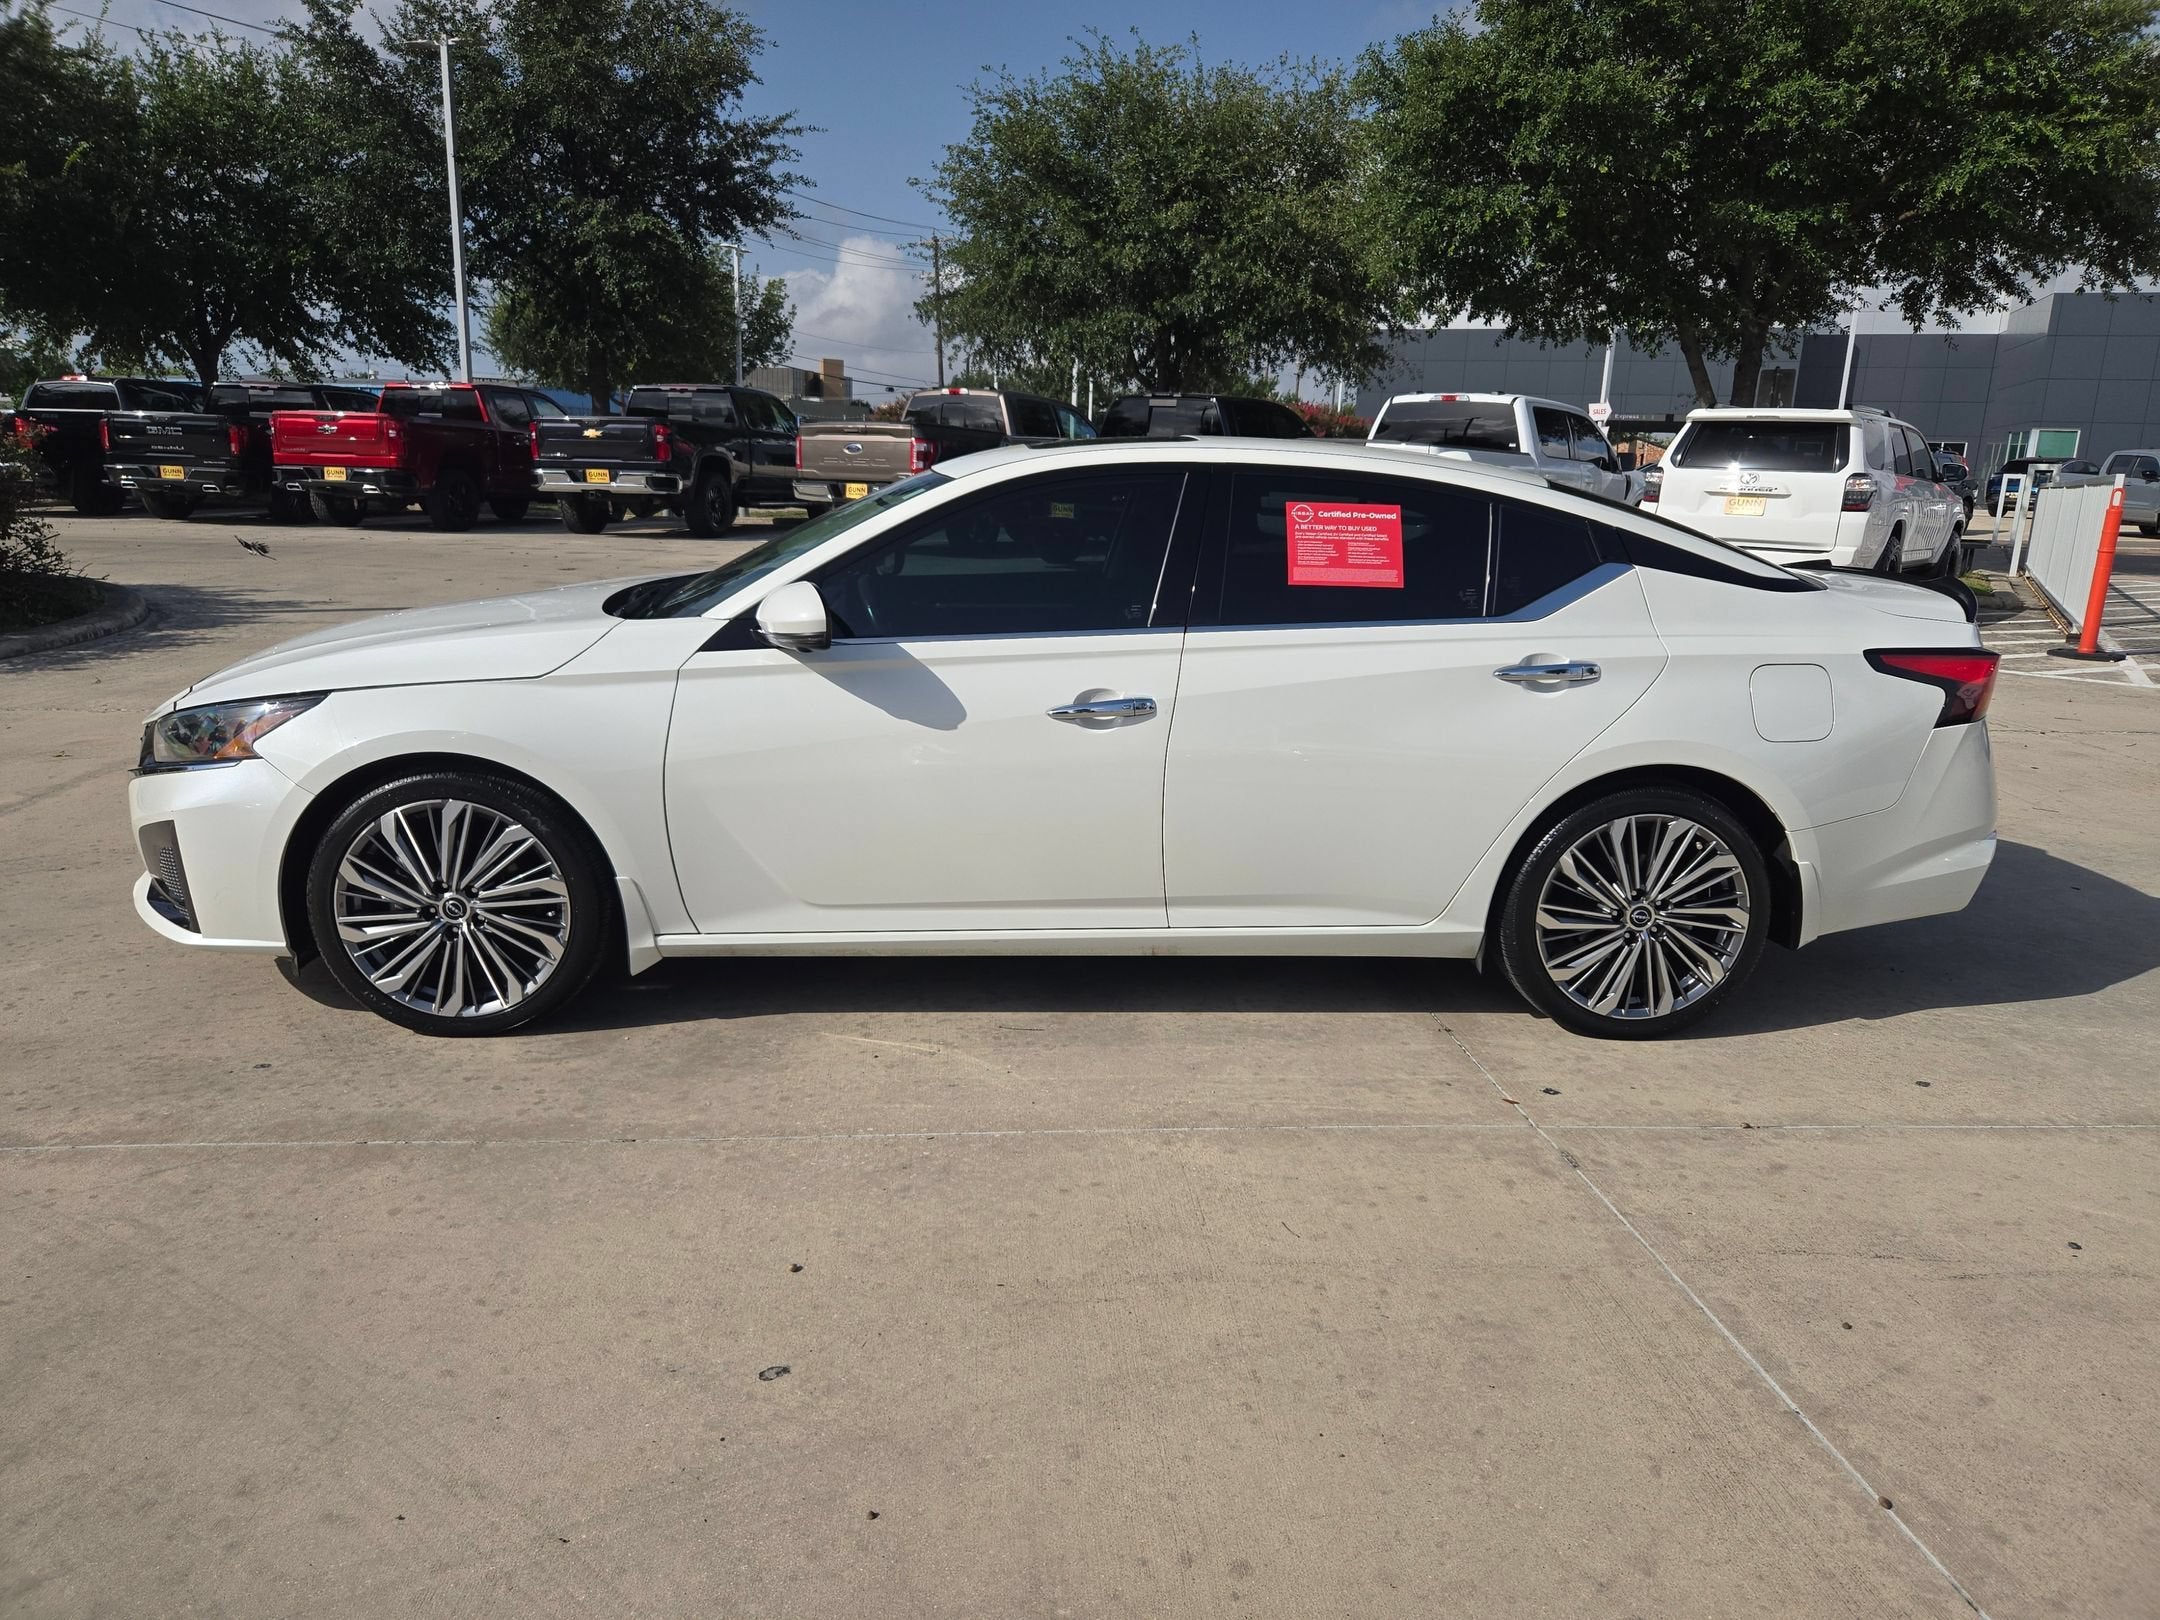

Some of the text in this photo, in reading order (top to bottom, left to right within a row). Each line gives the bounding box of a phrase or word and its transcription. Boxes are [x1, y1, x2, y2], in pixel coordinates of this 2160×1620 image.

[1728, 498, 1762, 506] GUNN
[1318, 510, 1397, 519] Certified Pre-Owned
